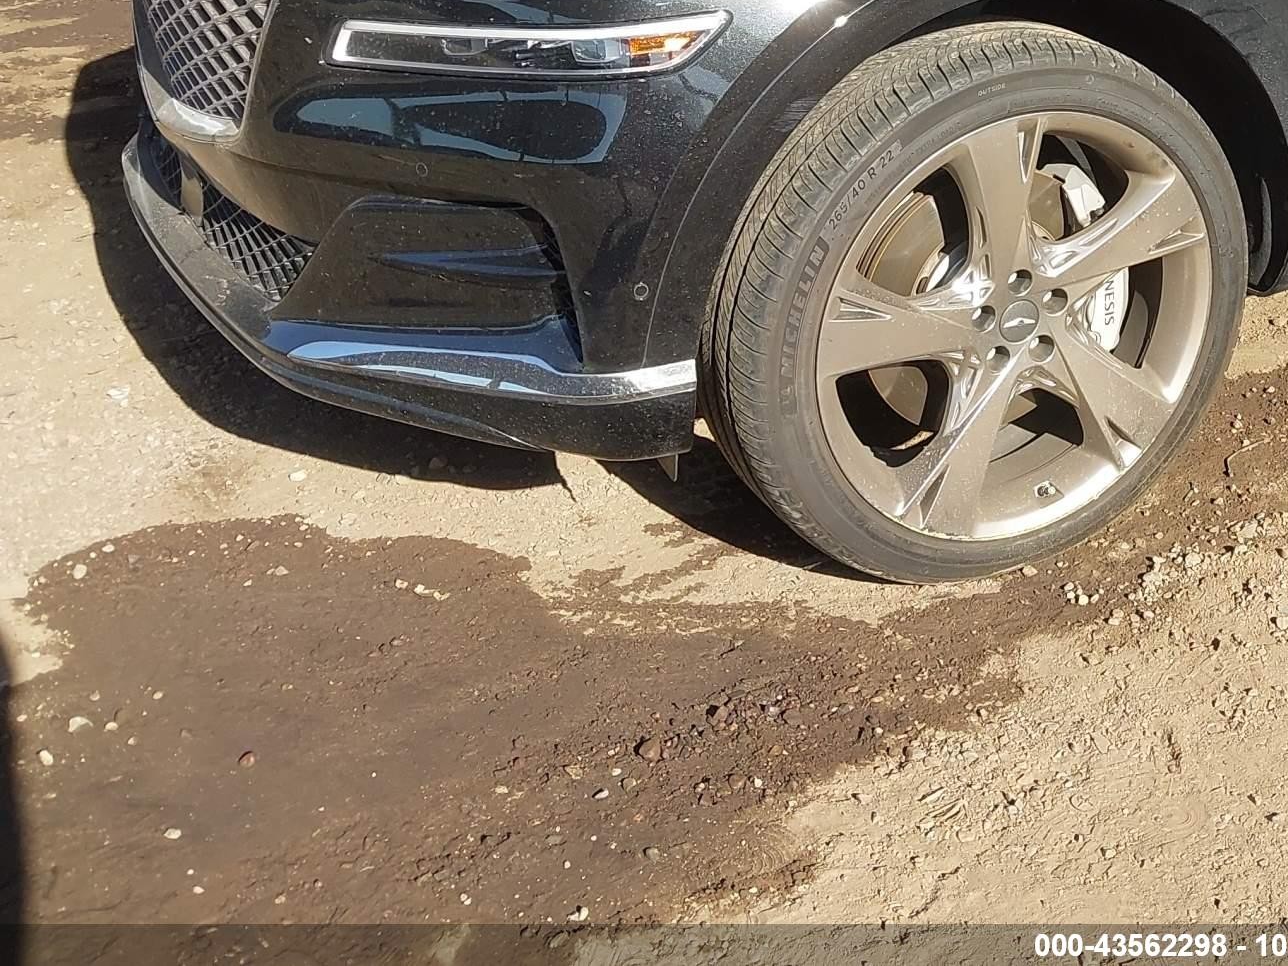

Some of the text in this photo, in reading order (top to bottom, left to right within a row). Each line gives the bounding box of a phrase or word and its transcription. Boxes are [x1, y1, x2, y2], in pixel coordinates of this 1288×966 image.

[977, 82, 1007, 97] OUTSIDE
[828, 149, 895, 231] 265/40 R 22
[780, 242, 825, 379] MICHELIN
